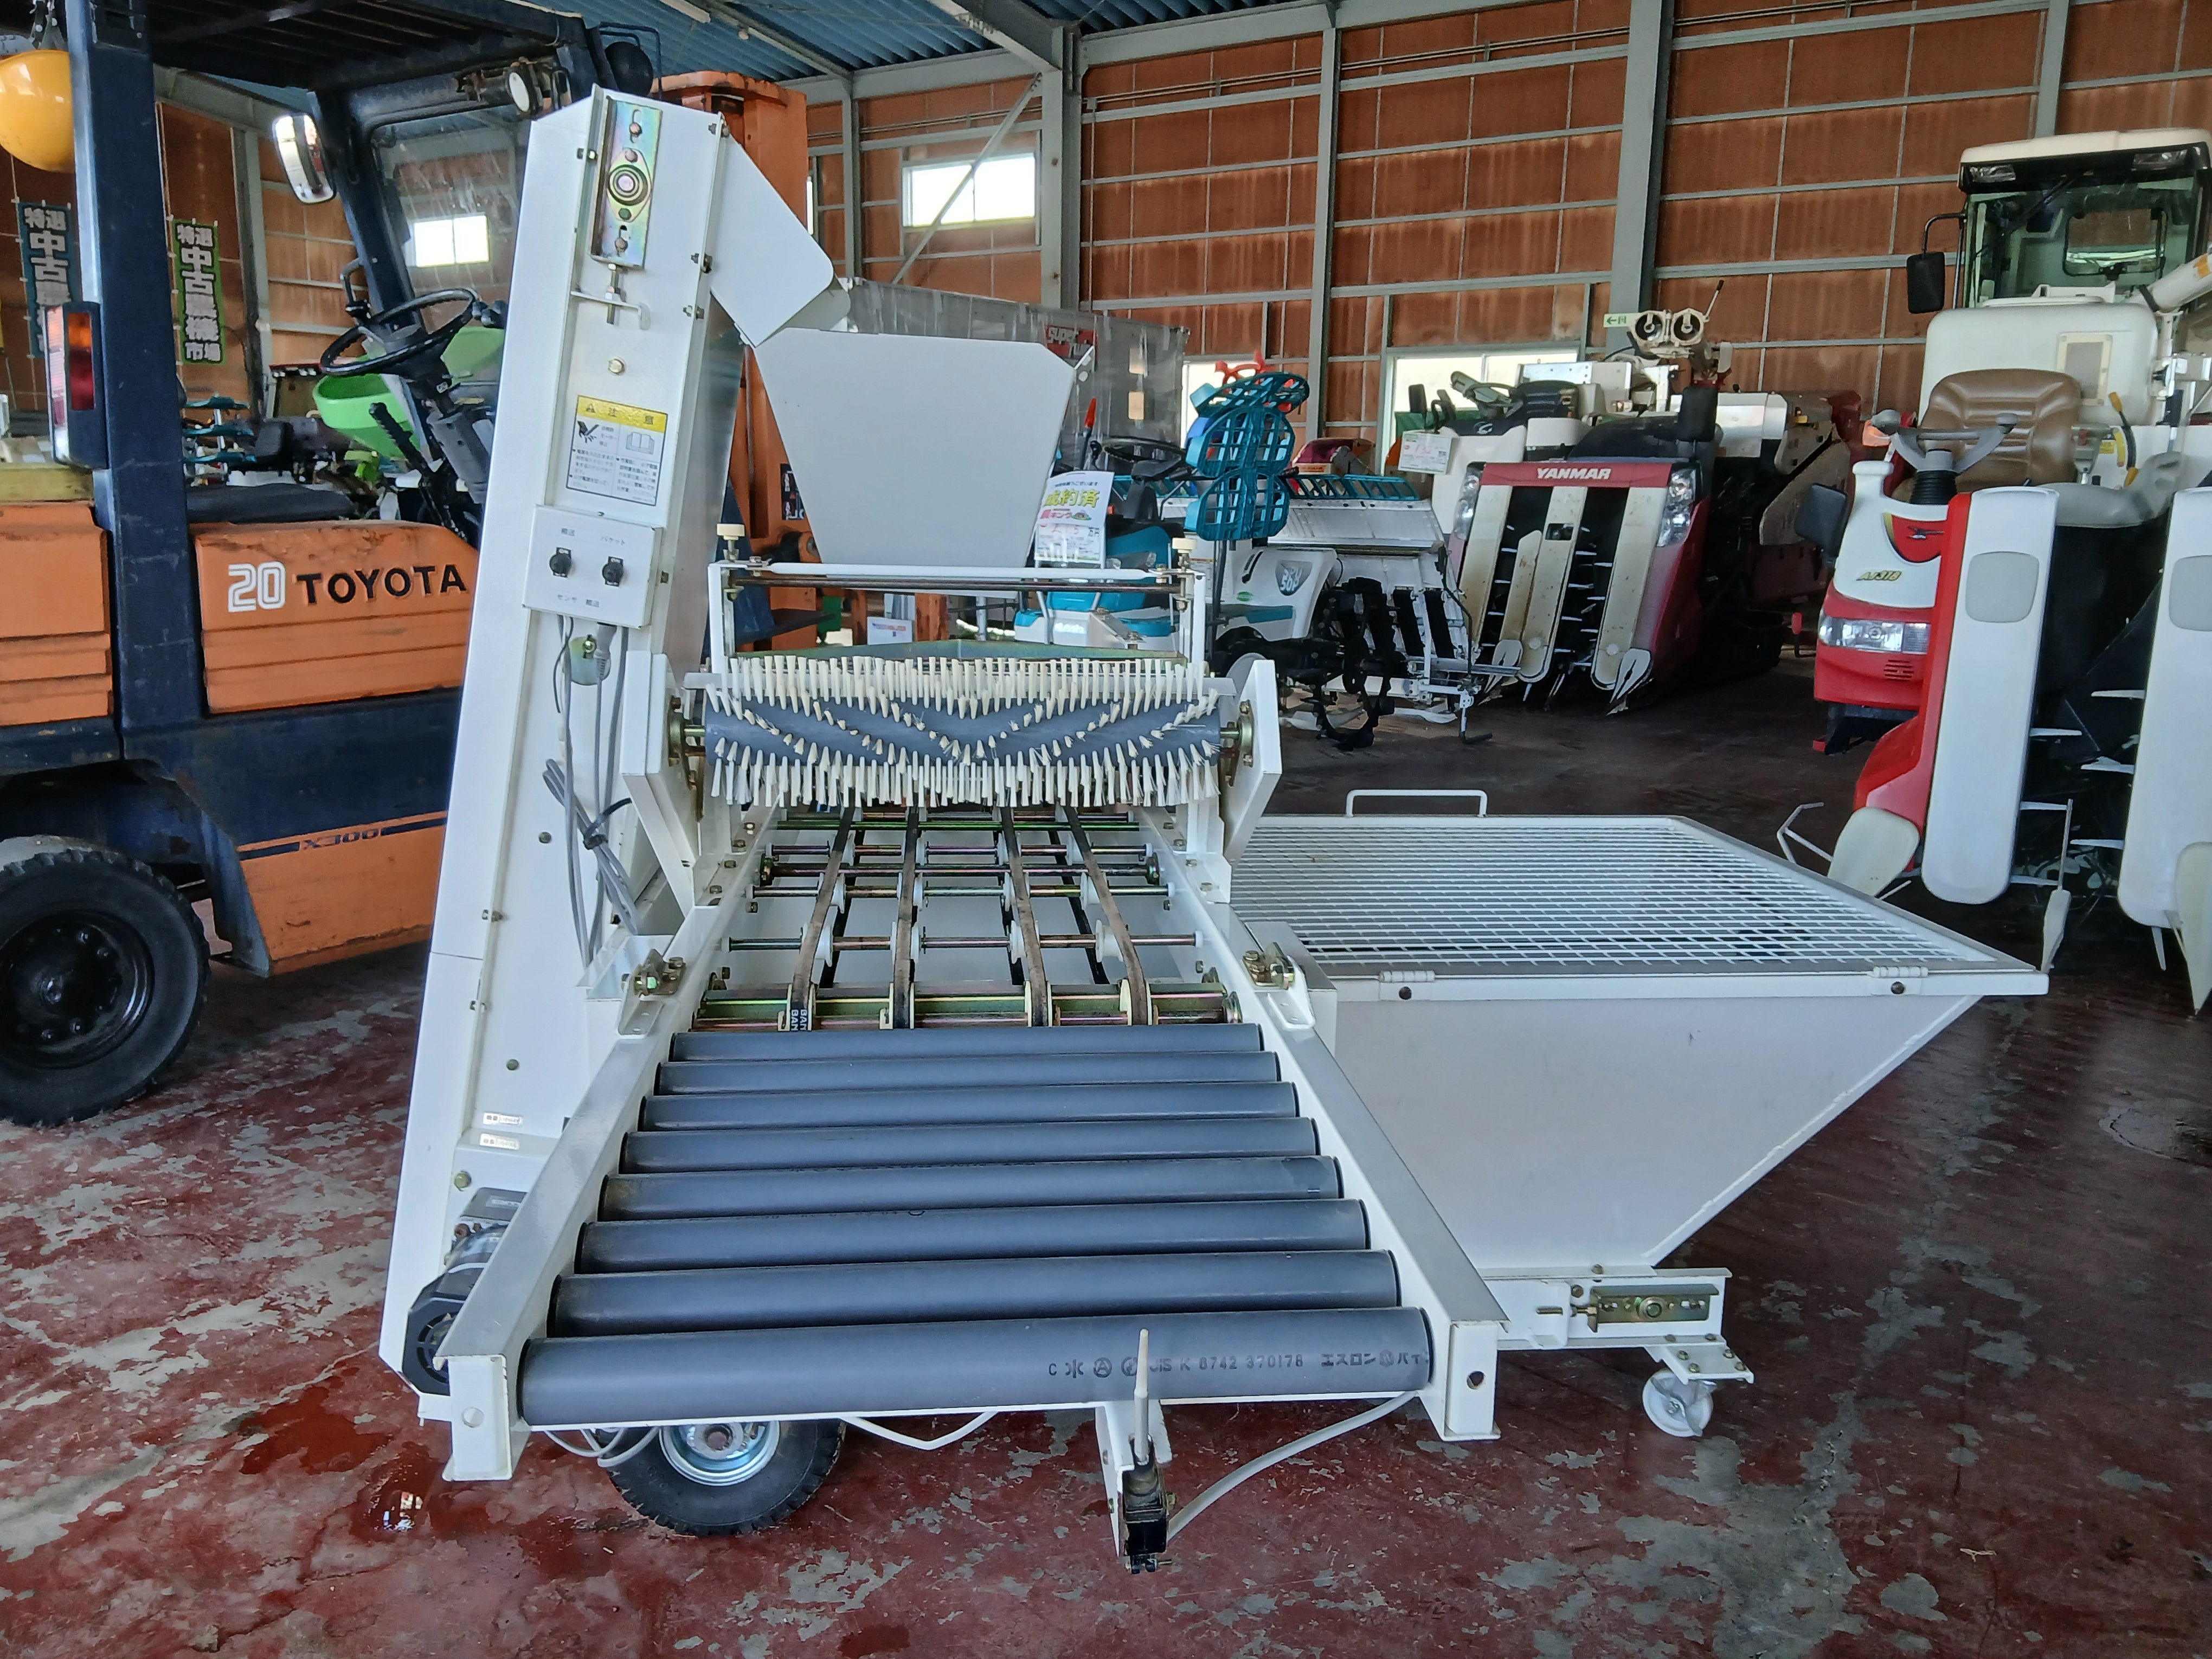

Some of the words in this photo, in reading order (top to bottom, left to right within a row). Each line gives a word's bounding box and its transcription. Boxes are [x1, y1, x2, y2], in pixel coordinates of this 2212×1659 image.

[1538, 468, 1611, 479] YANMAR
[1044, 488, 1100, 508] 成約済
[228, 562, 285, 612] 20
[296, 564, 467, 605] TOYOTA
